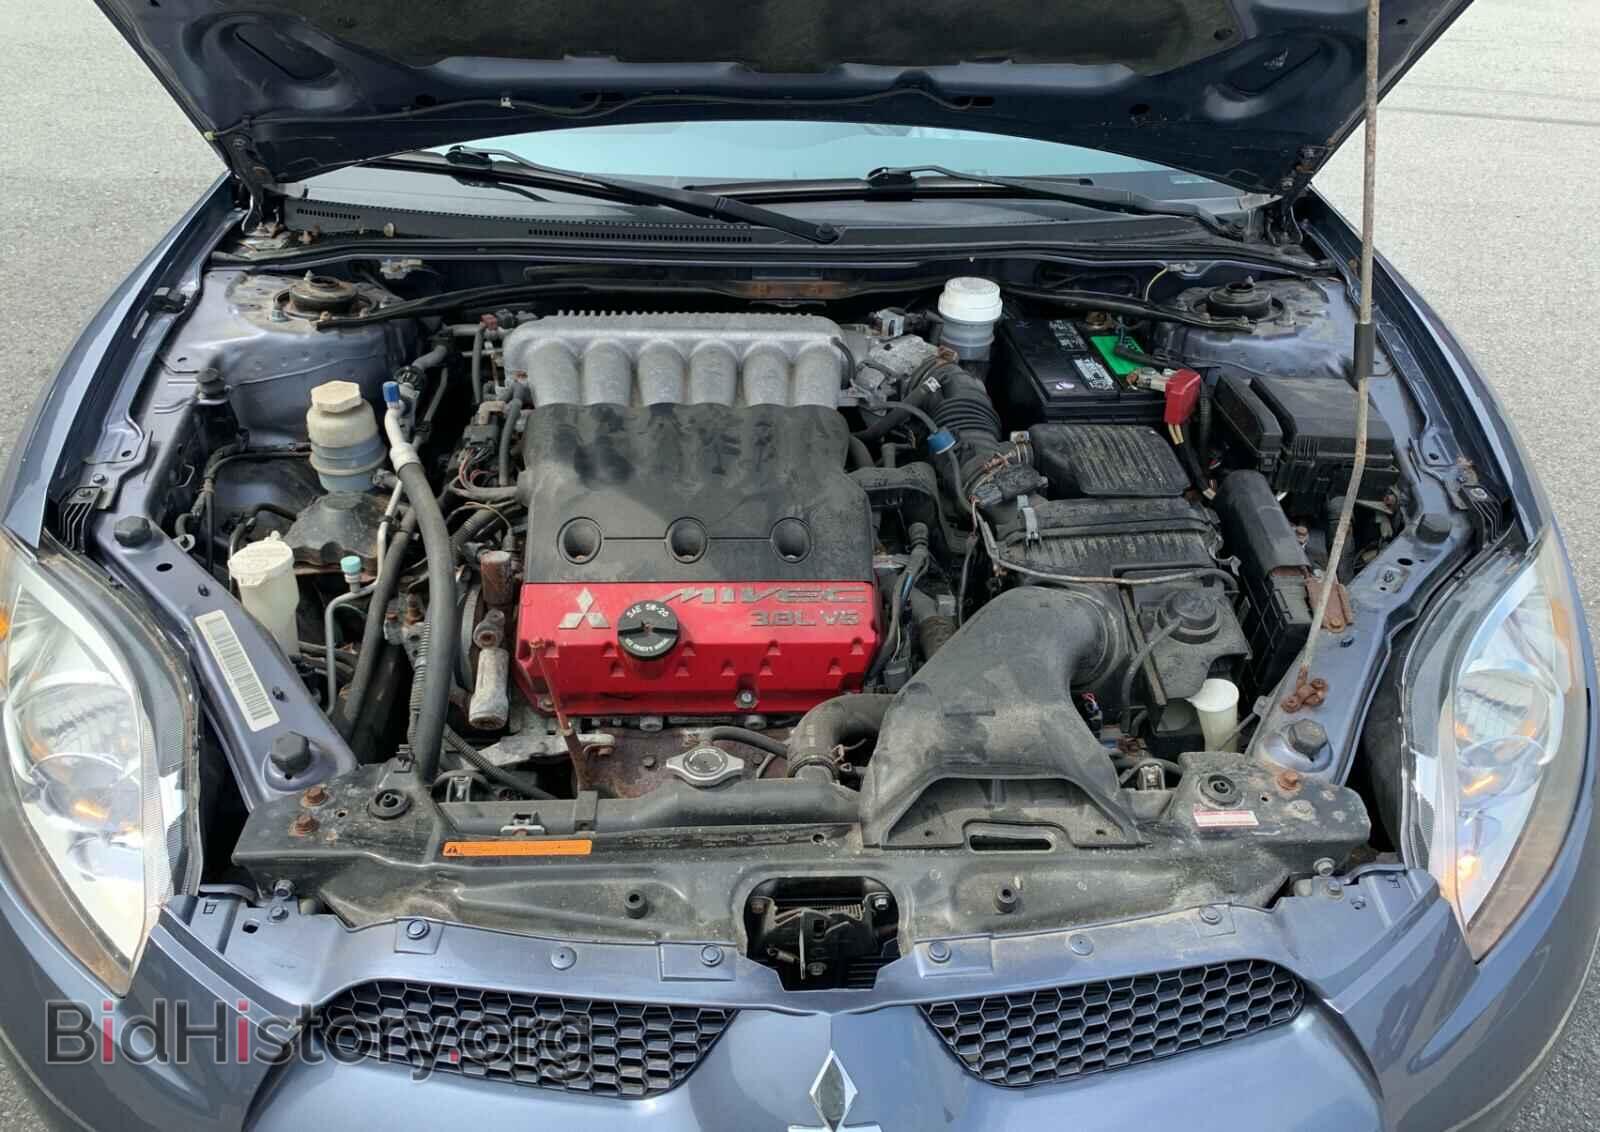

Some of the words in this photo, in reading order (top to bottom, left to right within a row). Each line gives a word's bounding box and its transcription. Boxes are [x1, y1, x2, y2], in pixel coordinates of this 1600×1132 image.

[660, 586, 866, 604] MIVEC
[626, 604, 642, 618] SAE
[819, 610, 859, 626] V6
